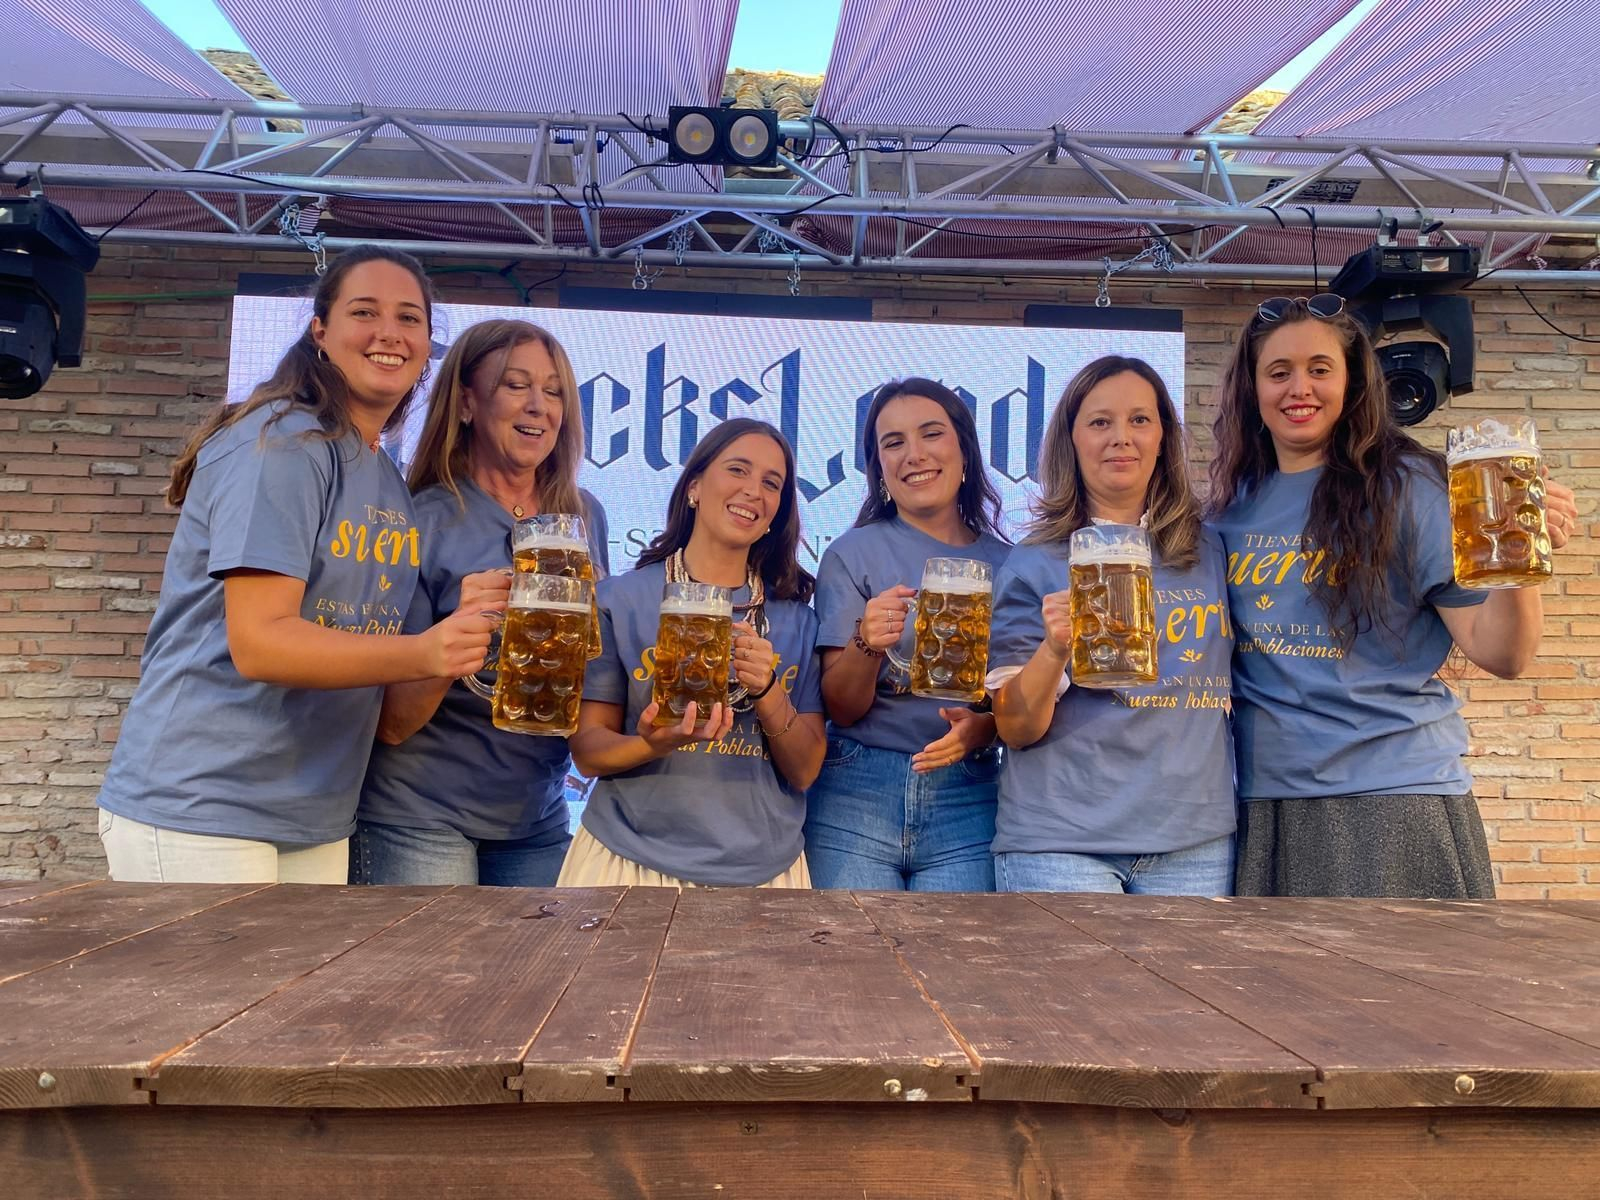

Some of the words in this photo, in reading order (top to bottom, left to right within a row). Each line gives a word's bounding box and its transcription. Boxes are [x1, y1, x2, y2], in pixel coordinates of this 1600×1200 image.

[1156, 588, 1206, 604] ENES
[363, 619, 403, 636] Pobl
[1253, 622, 1283, 634] UNA
[1290, 623, 1310, 635] DE
[1185, 690, 1232, 709] Poblac
